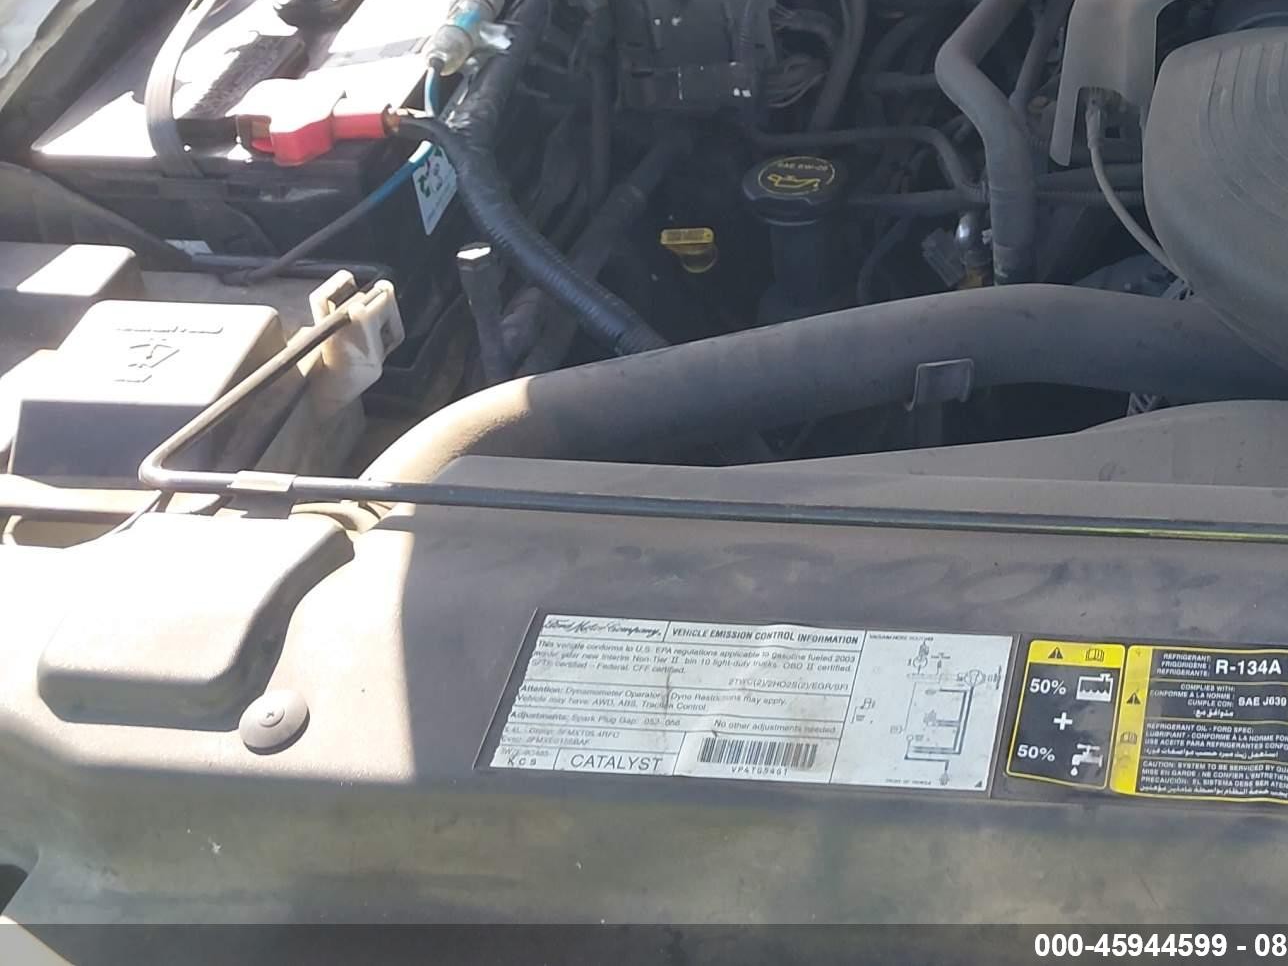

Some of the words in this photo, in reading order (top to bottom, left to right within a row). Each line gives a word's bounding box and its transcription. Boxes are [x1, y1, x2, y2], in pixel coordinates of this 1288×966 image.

[672, 628, 707, 638] VEHICLE
[709, 629, 752, 640] EMISSION
[754, 631, 795, 641] CONTROL
[797, 633, 859, 644] INFORMATION
[673, 648, 718, 657] regulations
[719, 649, 760, 659] applicable
[808, 653, 833, 662] fueled
[834, 654, 855, 663] 2003
[783, 662, 802, 670] OBD
[1215, 658, 1282, 676] R-134A
[1030, 677, 1067, 695] 50%
[1180, 683, 1215, 692] COMPLIES
[670, 692, 693, 701] Dyno
[743, 695, 761, 705] may
[1187, 699, 1215, 707] CUMPLE
[1237, 696, 1260, 707] SAE
[1262, 696, 1287, 707] J639
[713, 719, 727, 727] No
[728, 721, 750, 729] other
[752, 722, 802, 732] adjustments
[1146, 722, 1194, 731] REFRIGERANT
[1195, 724, 1208, 732] OIL
[1213, 724, 1232, 733] FORD
[1191, 732, 1231, 741] CONFORME
[1248, 734, 1274, 742] NORME
[1144, 738, 1159, 746] USE
[1159, 739, 1185, 747] ACEITE
[1186, 740, 1205, 748] PARA
[1206, 741, 1264, 749] REFRIGERANTES
[1016, 744, 1056, 762] 50%
[570, 753, 664, 771] CATALYST
[1177, 761, 1206, 770] SYSTEM
[1229, 764, 1264, 772] SERVICED
[1141, 768, 1159, 776] MISE
[1202, 778, 1233, 787] SISTEMA
